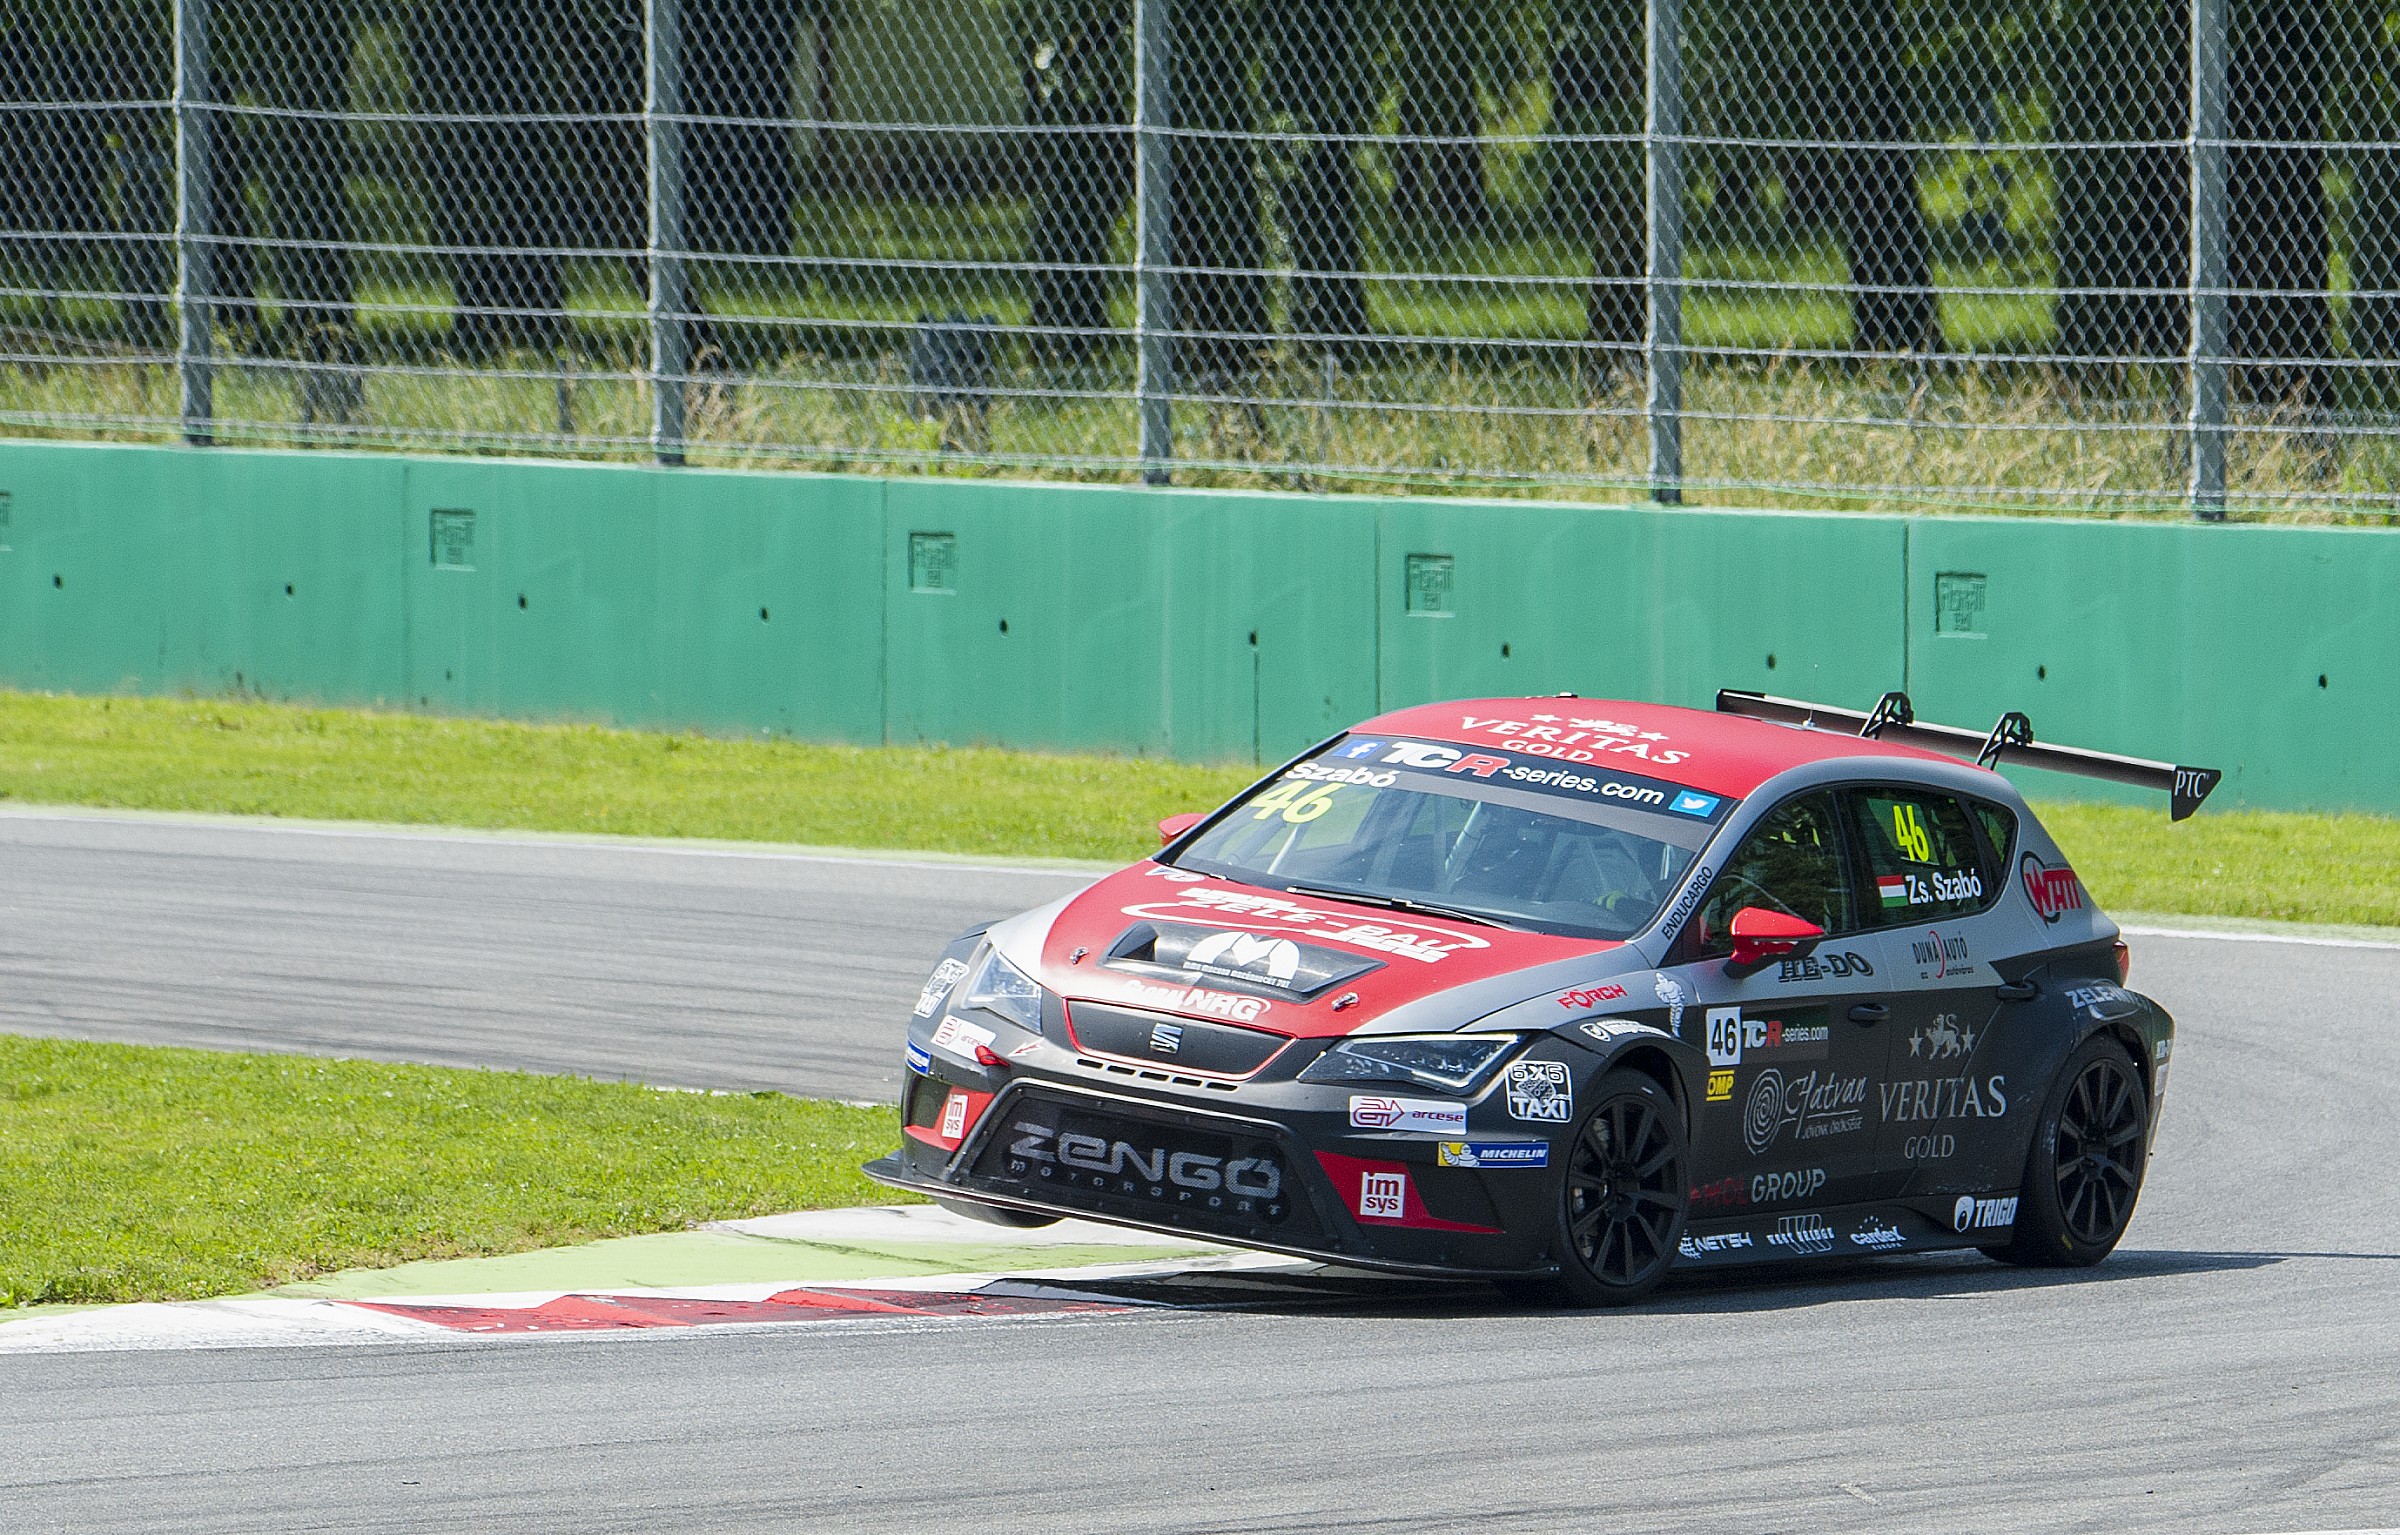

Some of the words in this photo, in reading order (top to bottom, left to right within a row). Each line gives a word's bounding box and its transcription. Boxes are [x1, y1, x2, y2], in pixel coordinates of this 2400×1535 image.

[1460, 716, 1691, 765] VERITAS
[1502, 739, 1594, 762] GOLD
[1285, 762, 1401, 788] Szabó
[2174, 770, 2206, 799] PTC
[1249, 780, 1347, 824] 46
[1893, 805, 1930, 862] 46
[1905, 874, 1933, 905] Zs.
[1932, 868, 1983, 902] Szabó
[1661, 866, 1714, 941] ENDUCARGO
[1778, 951, 1875, 983] HE-DO
[1183, 988, 1263, 1022] NRG
[1711, 1017, 1738, 1057] 46
[1707, 1074, 1735, 1096] OMP
[1879, 1075, 2008, 1122] VERITAS
[1412, 1109, 1465, 1123] arcese
[1511, 1097, 1568, 1120] TAXI
[1480, 1148, 1547, 1160] MICHELIN
[1904, 1134, 1956, 1160] GOLD
[1751, 1168, 1827, 1203] GROUP
[1366, 1196, 1399, 1214] sys
[1975, 1197, 2019, 1228] TRIGO
